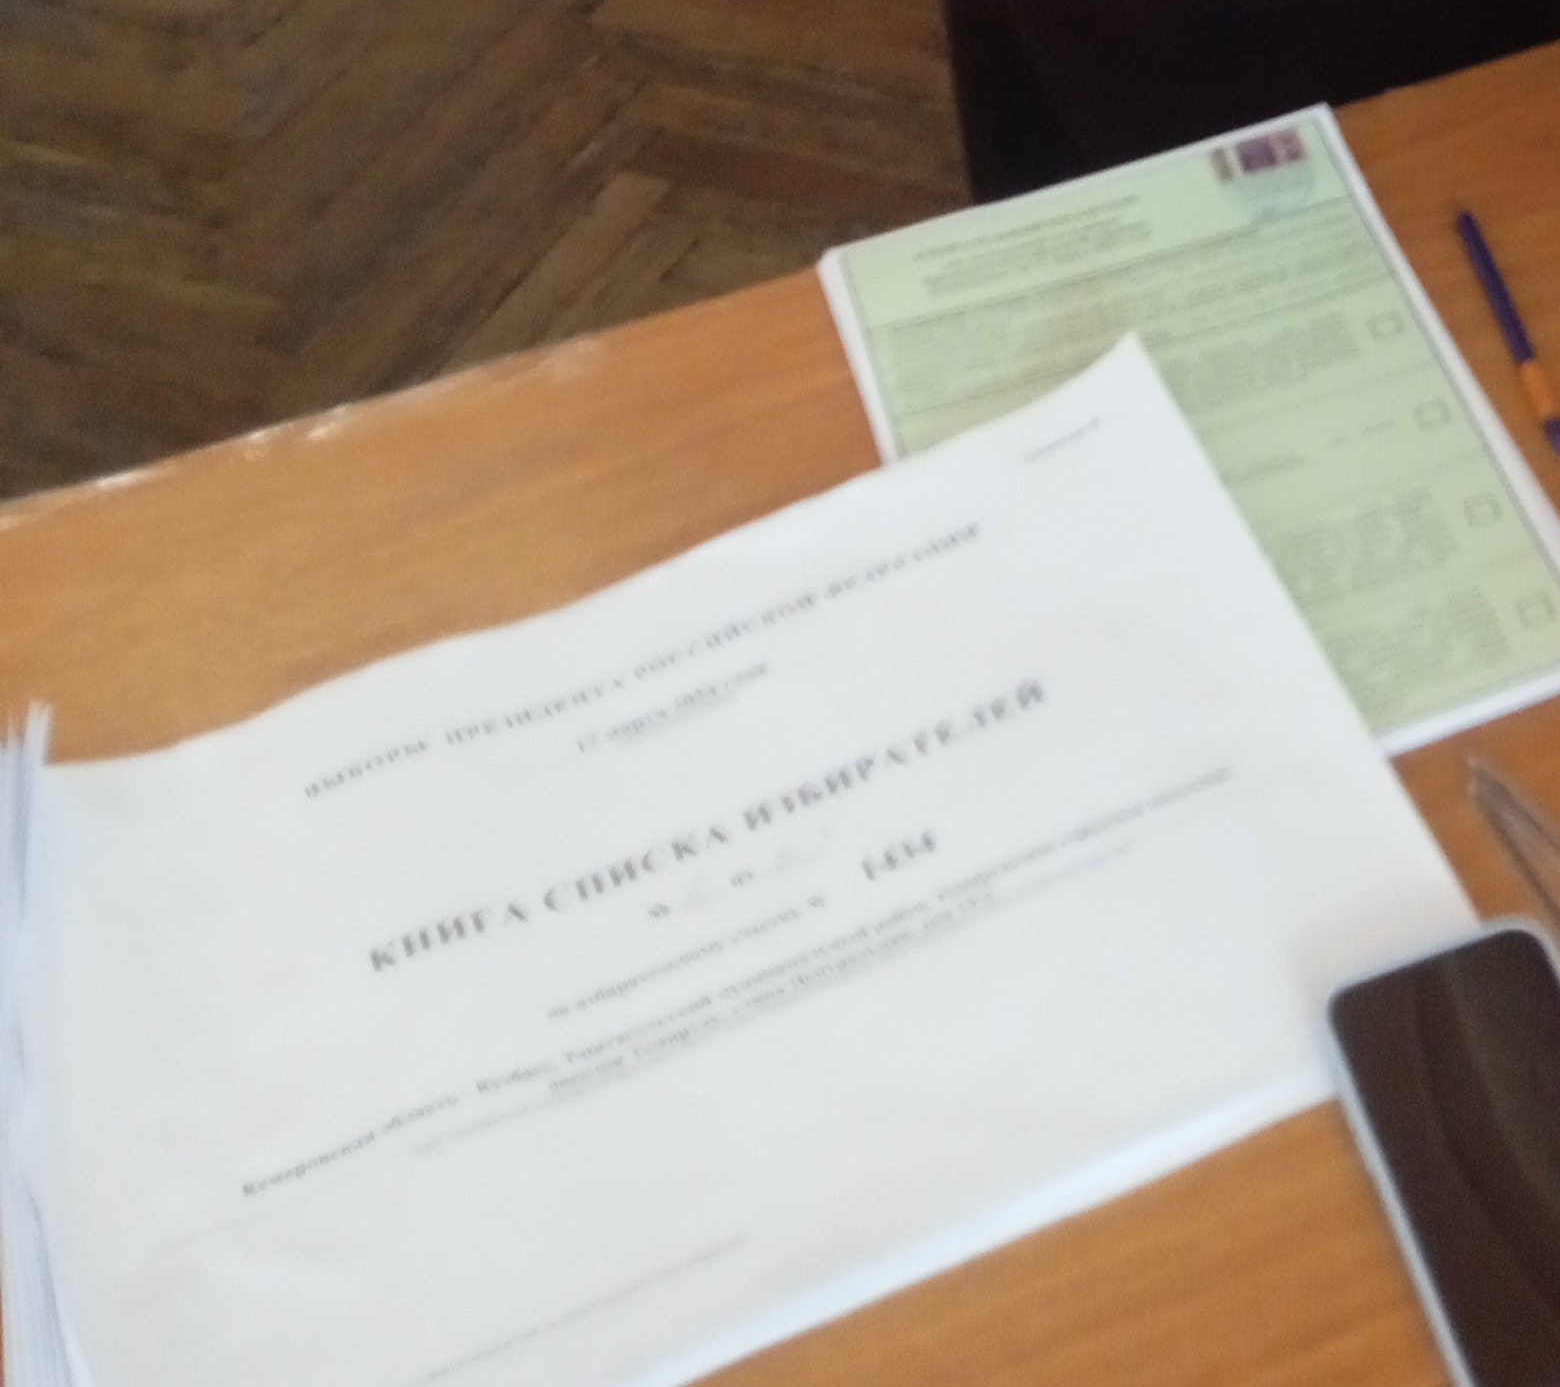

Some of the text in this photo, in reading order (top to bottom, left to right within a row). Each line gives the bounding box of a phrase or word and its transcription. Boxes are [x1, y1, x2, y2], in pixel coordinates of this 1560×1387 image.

[368, 899, 530, 972] КНИГА
[542, 824, 729, 913] СПИСКА
[742, 676, 1046, 830] ИЗБИРАТЕЛЕЙ
